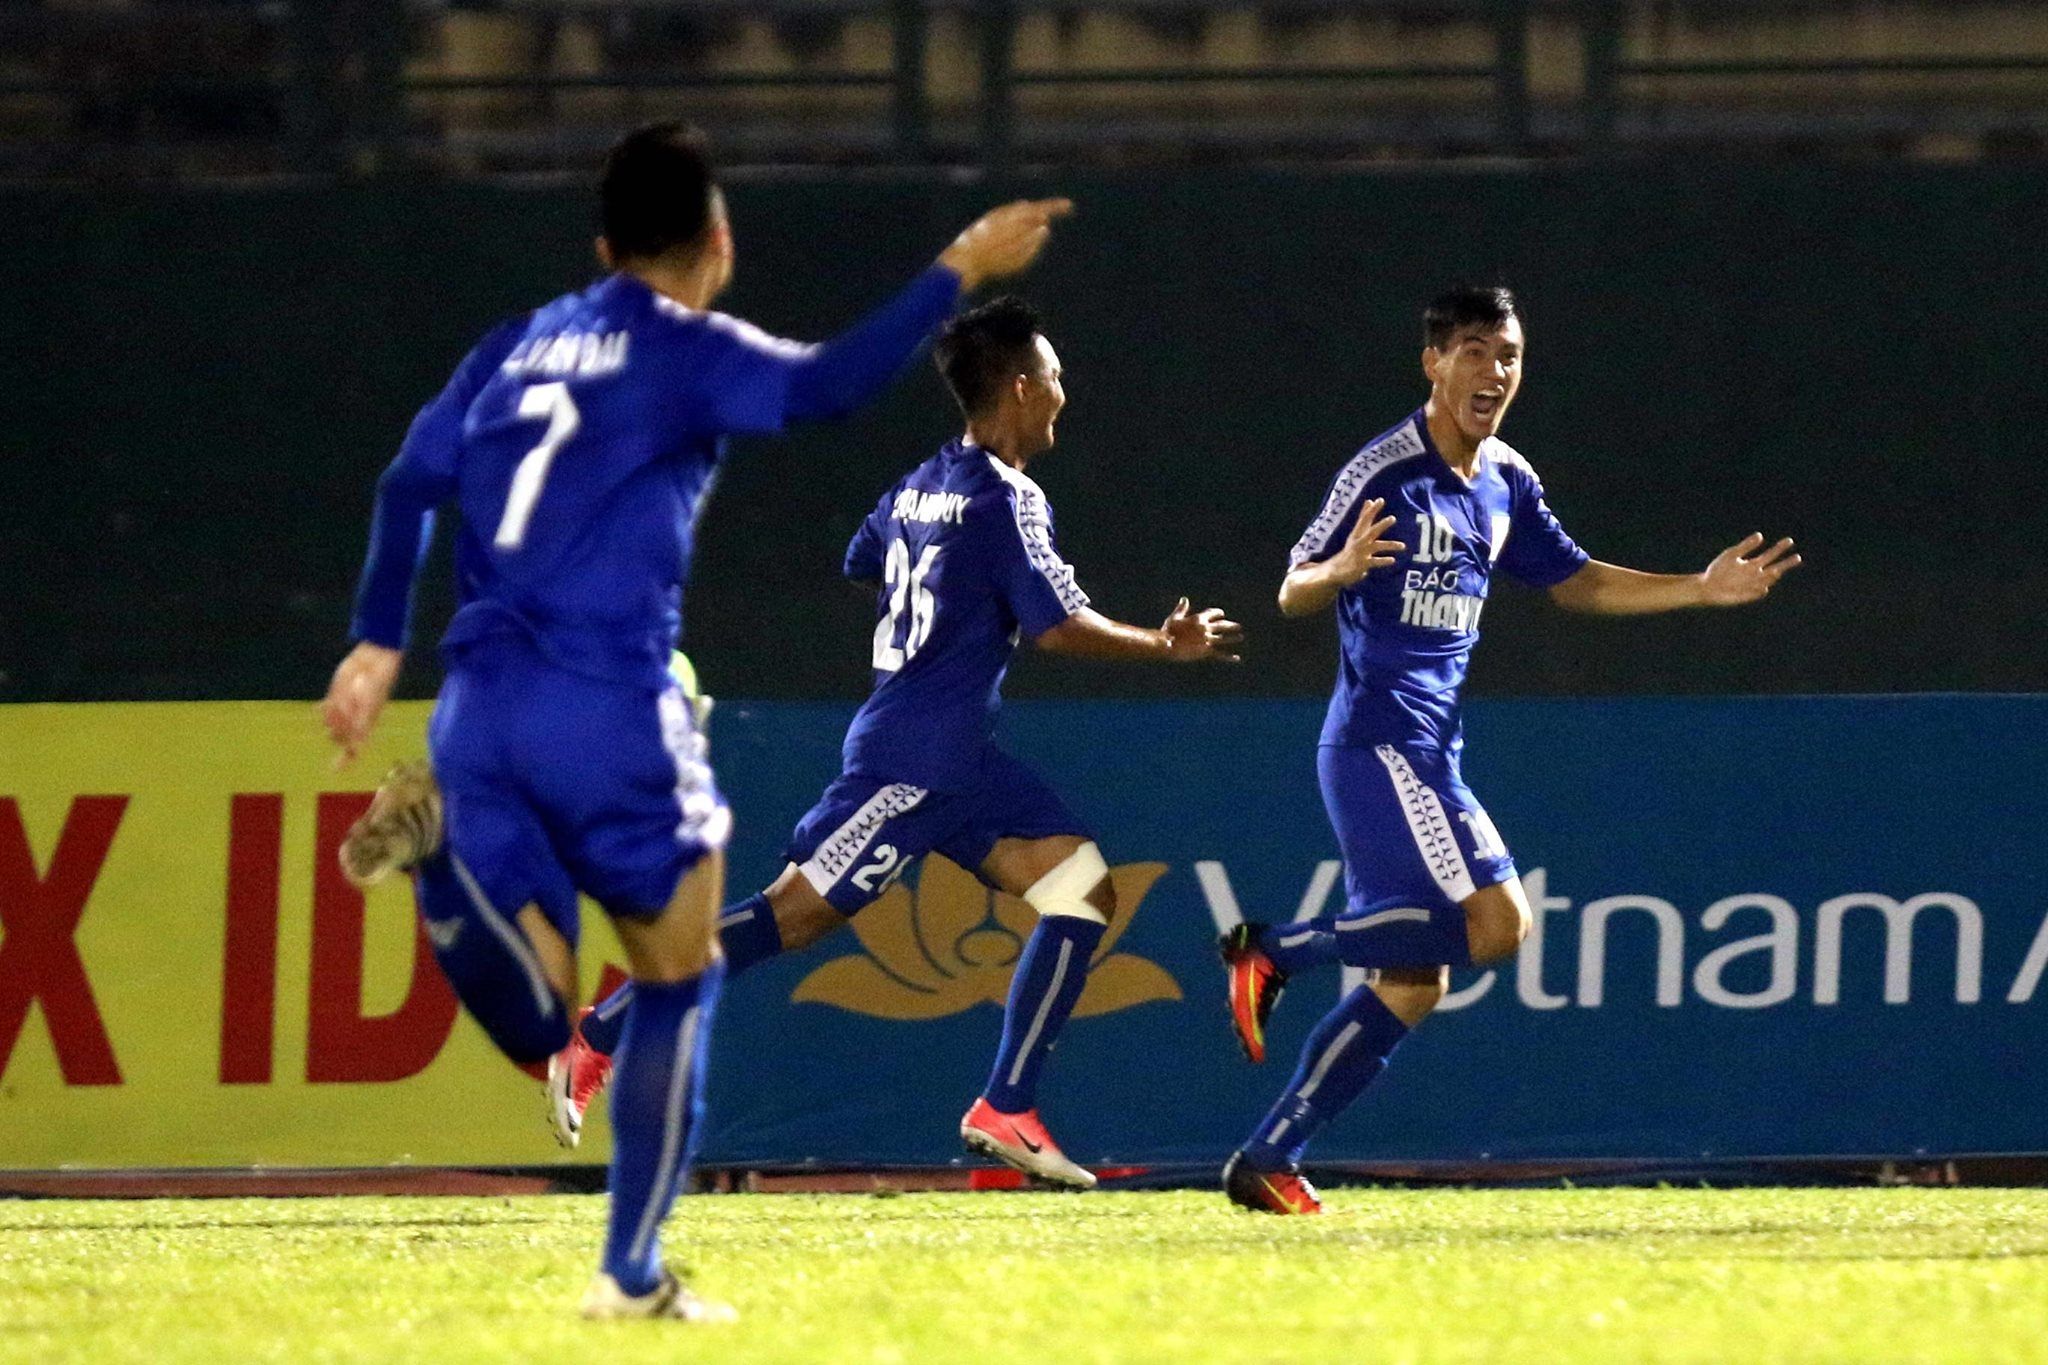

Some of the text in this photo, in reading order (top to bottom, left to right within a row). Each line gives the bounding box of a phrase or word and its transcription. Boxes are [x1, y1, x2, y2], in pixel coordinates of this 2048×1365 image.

[494, 381, 580, 551] 7
[872, 538, 942, 672] 26
[1412, 513, 1454, 563] 10
